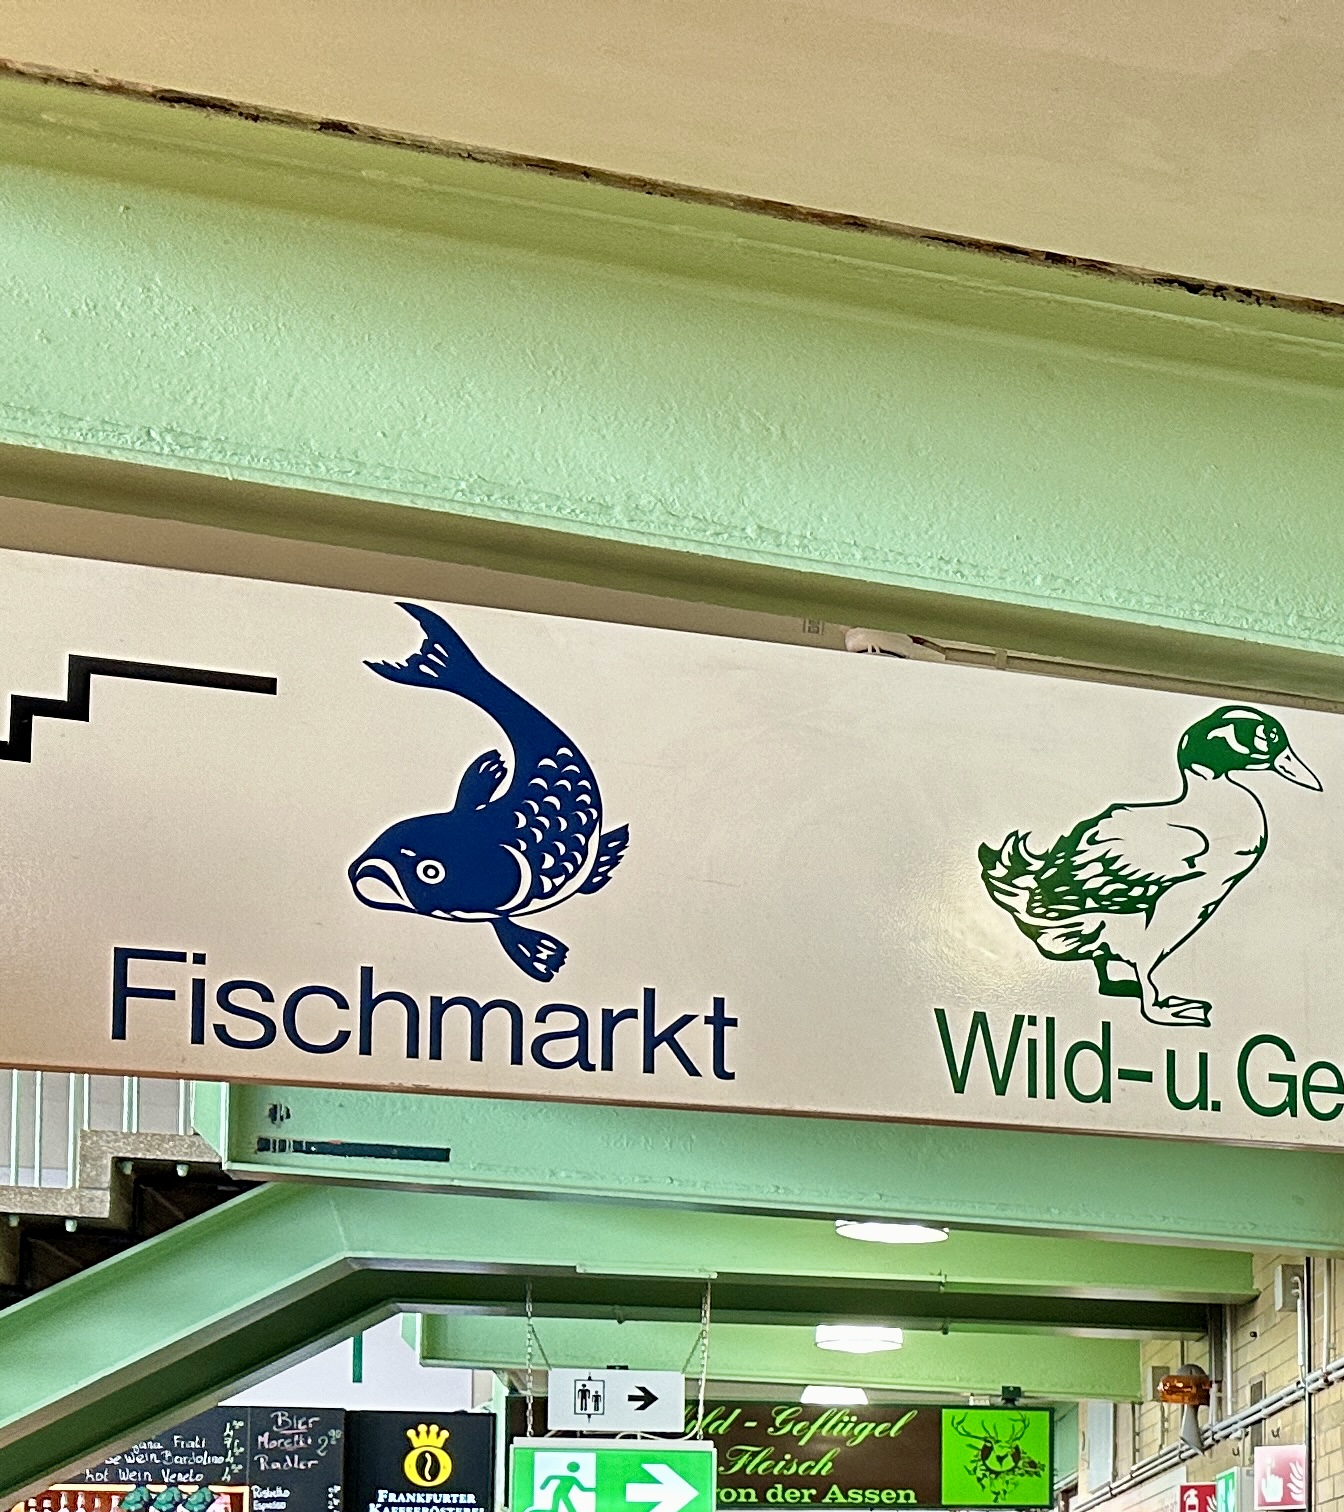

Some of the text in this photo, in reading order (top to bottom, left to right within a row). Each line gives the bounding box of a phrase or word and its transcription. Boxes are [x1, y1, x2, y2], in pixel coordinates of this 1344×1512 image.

[110, 946, 739, 1081] Fischmarkt
[271, 1411, 321, 1432] Bier
[767, 1405, 918, 1447] Geflügel
[258, 1434, 313, 1450] Moretti
[254, 1454, 319, 1471] Radler
[718, 1445, 841, 1476] Fleisch
[118, 1467, 153, 1481] Wein
[766, 1484, 917, 1504] der Assen
